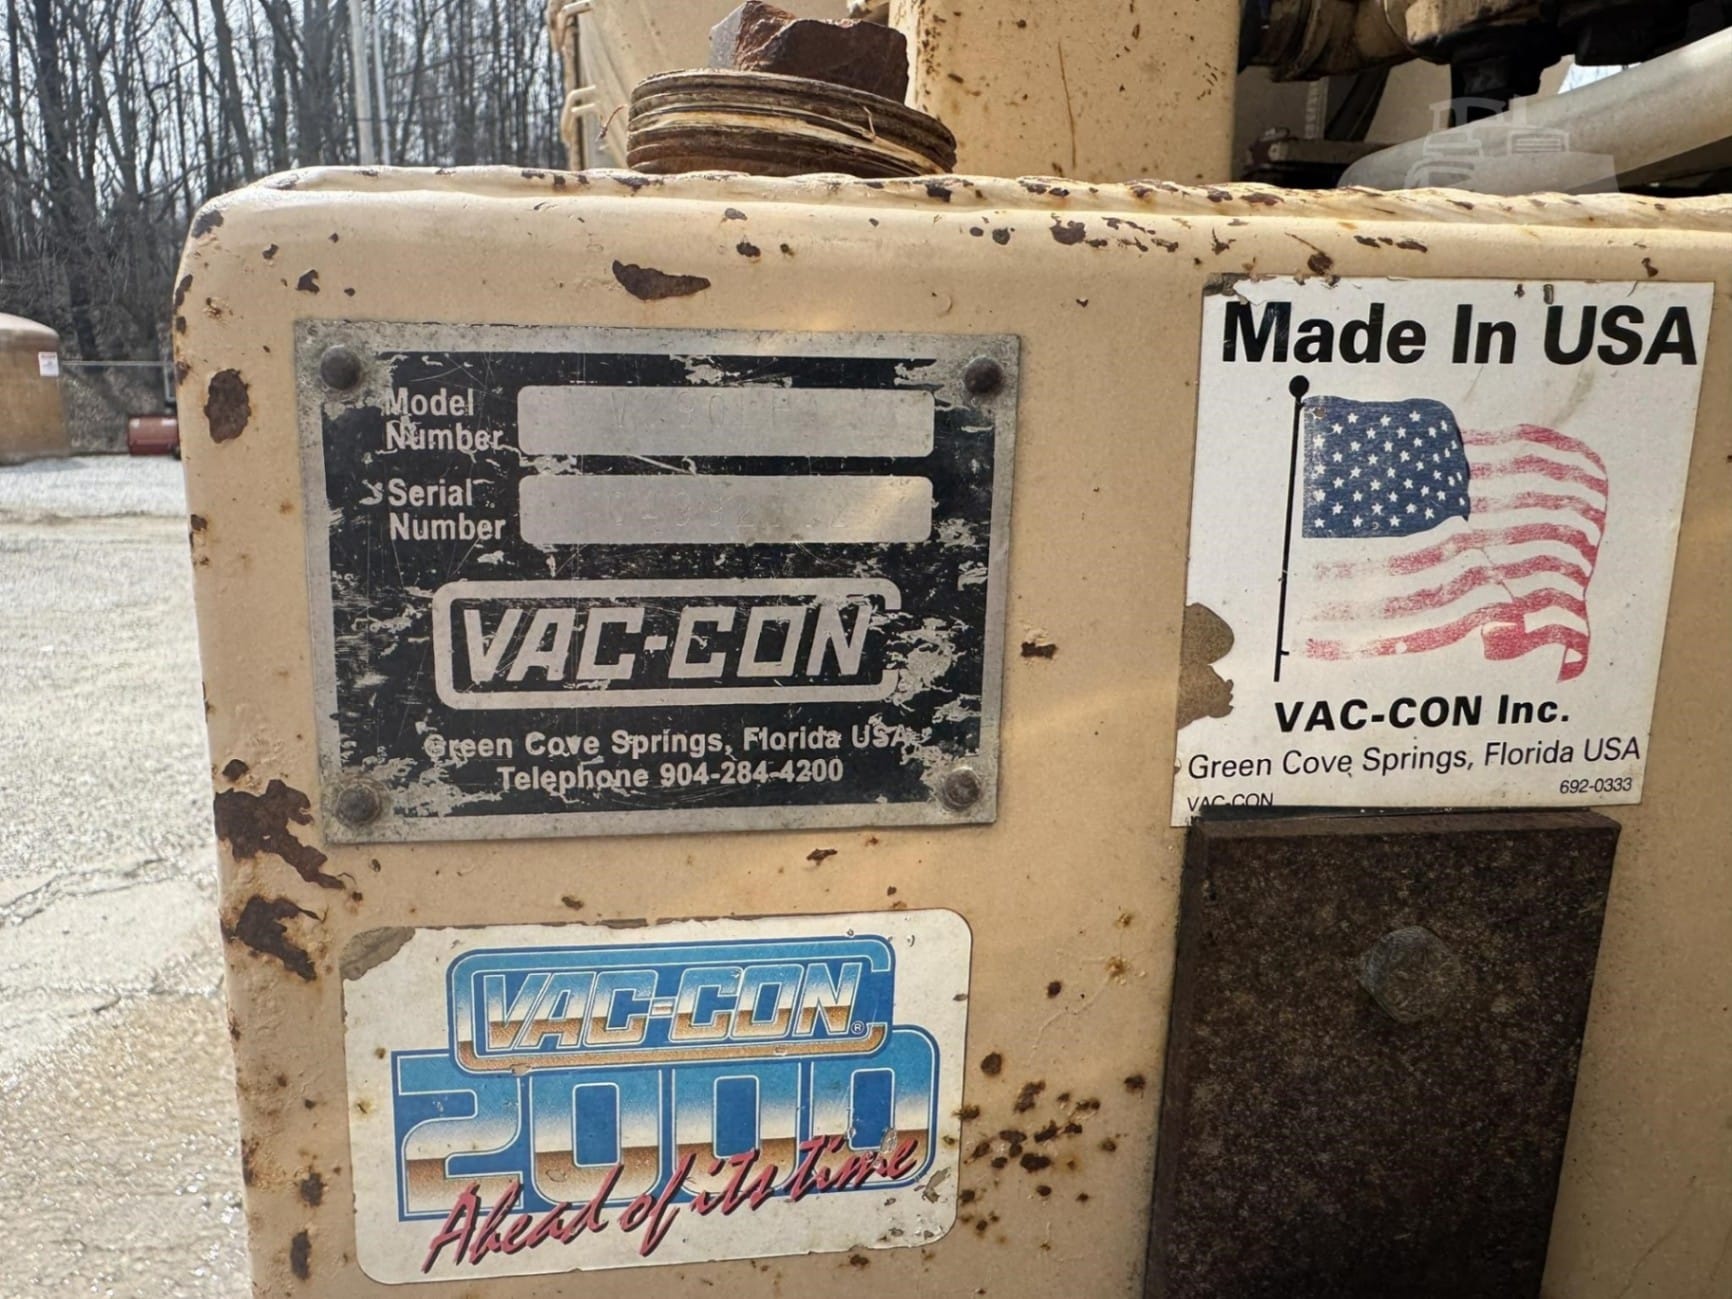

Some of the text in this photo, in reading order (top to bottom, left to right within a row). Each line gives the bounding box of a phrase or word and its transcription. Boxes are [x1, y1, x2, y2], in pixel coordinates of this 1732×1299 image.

[1222, 302, 1698, 365] Made In USA
[386, 387, 475, 417] Model
[385, 422, 504, 451] Number
[388, 478, 473, 507] Serial
[389, 511, 507, 541] Number
[461, 604, 873, 681] VAC-CON
[1274, 694, 1570, 733] VAC-CON Inc.
[423, 722, 908, 759] Green Cove Springs, Florida USA
[1188, 736, 1641, 779] Green Cove Springs, Florida USA
[497, 758, 844, 796] Telephone 904-284-4200
[1559, 777, 1633, 794] 692-0333
[420, 1163, 624, 1274] Ahead
[618, 1150, 697, 1257] of
